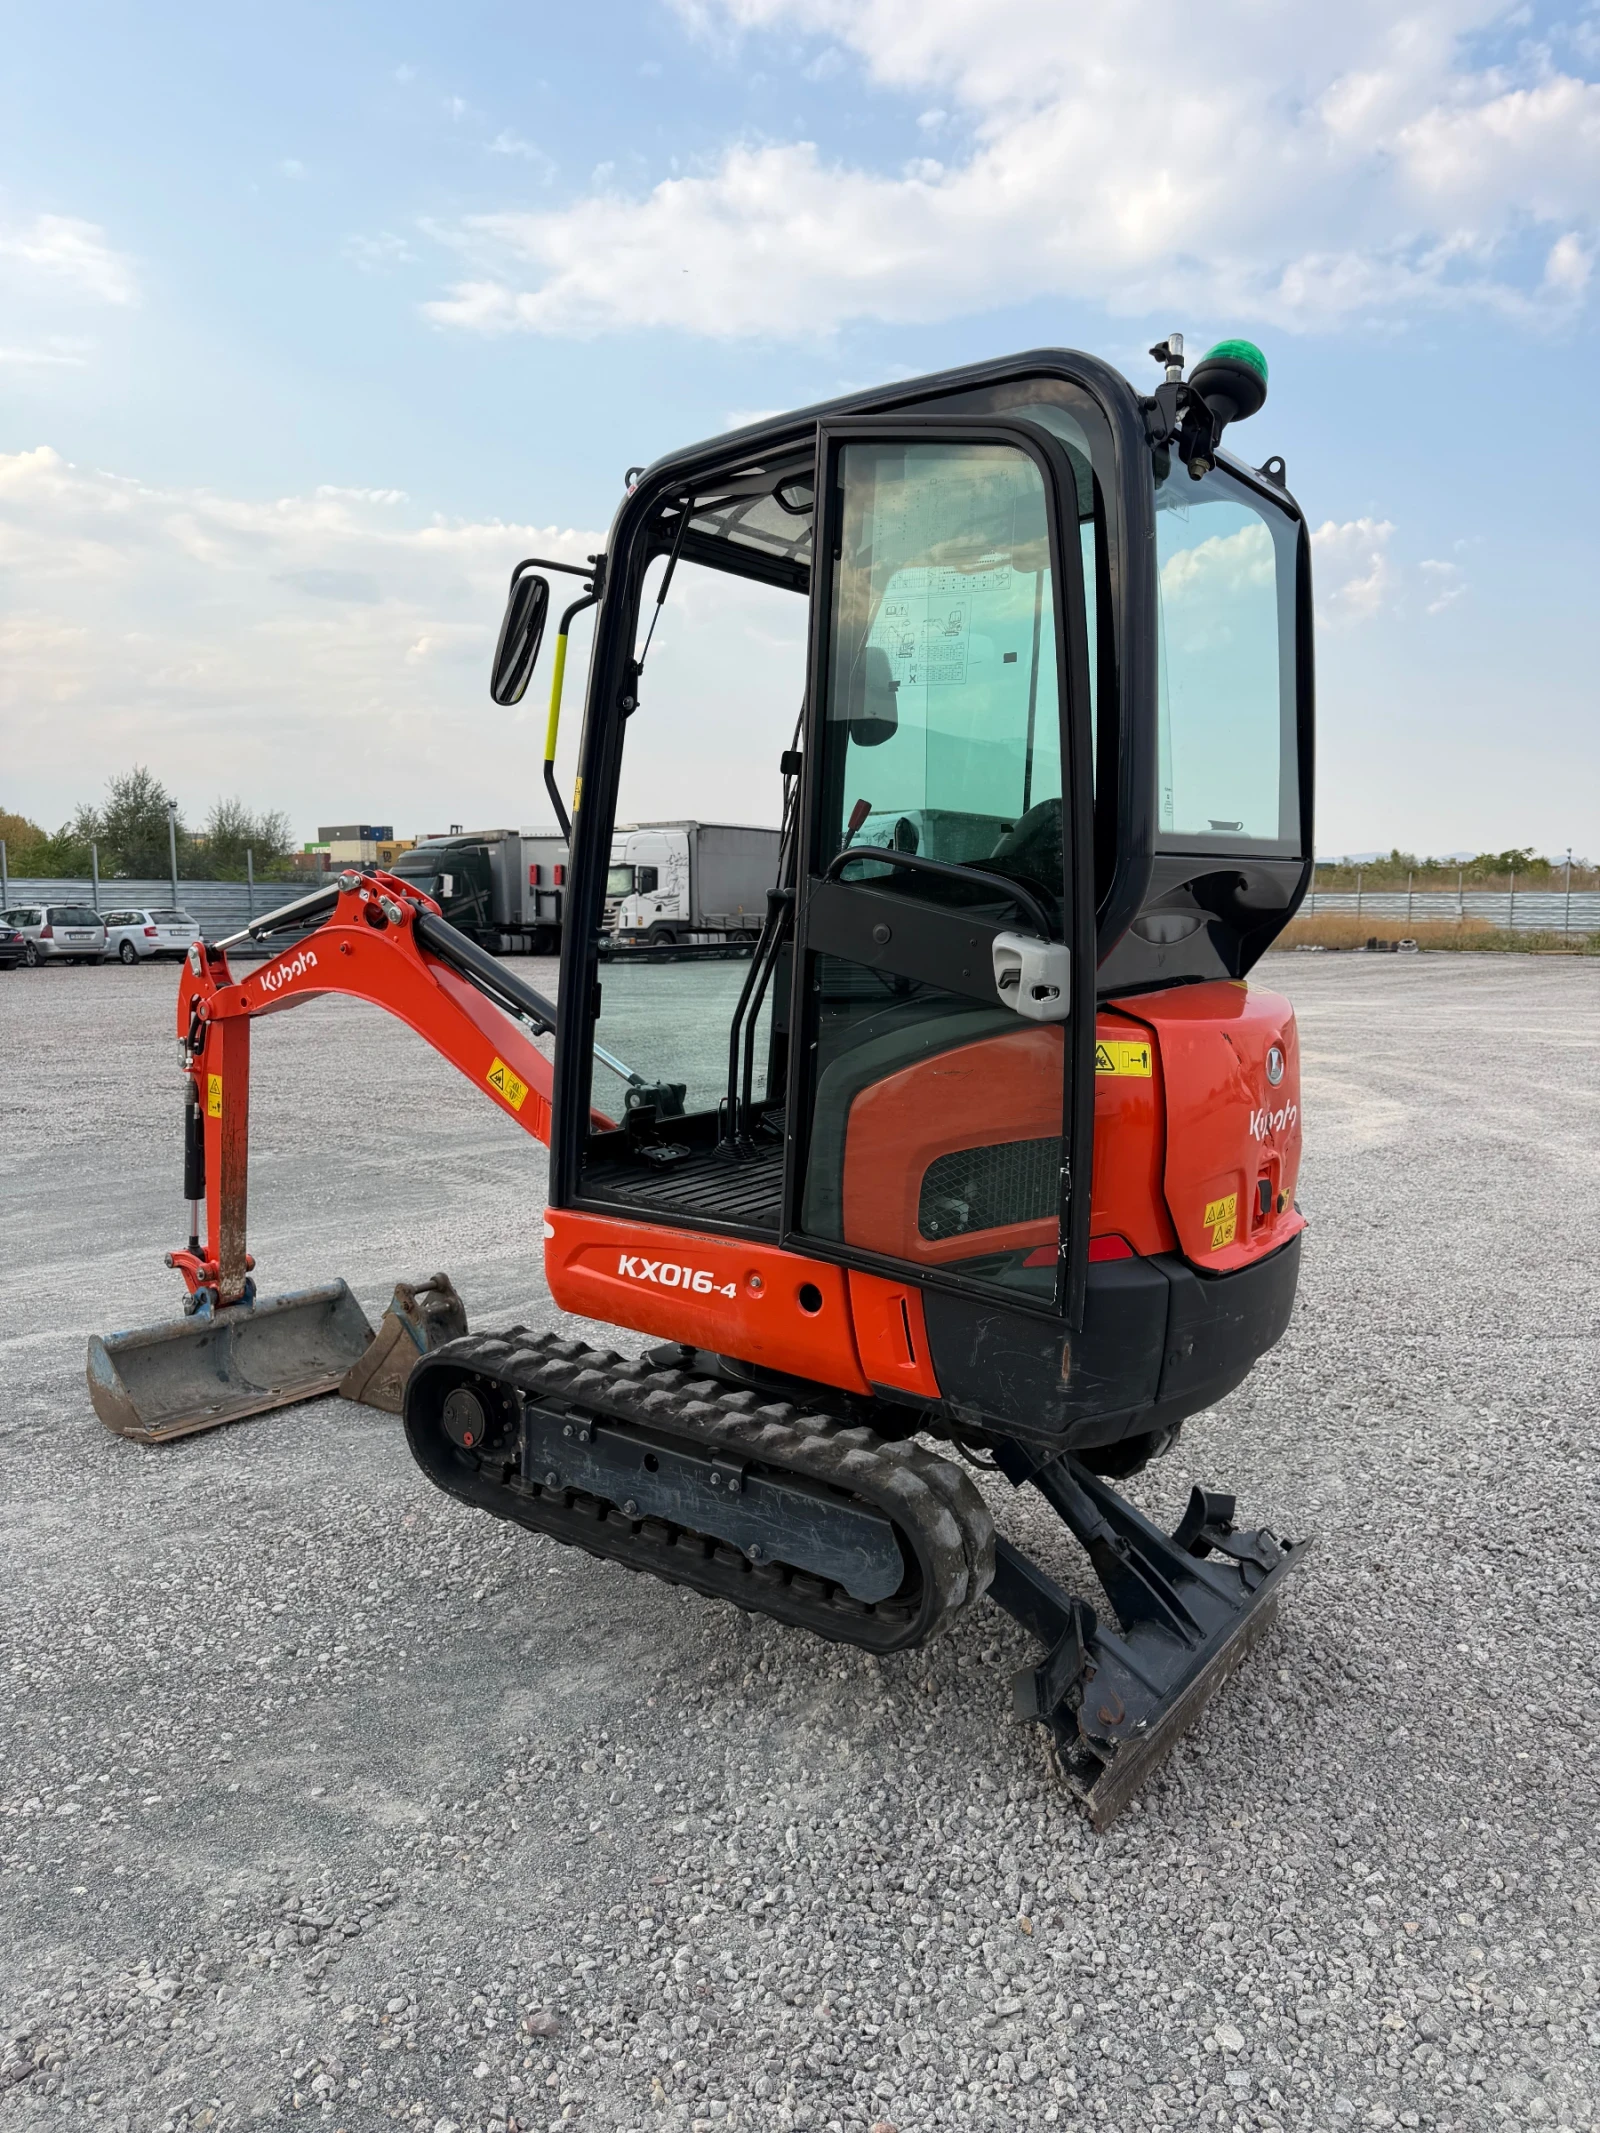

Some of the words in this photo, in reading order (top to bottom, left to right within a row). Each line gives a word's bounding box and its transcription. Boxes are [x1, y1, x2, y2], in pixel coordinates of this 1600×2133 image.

[260, 951, 318, 991] Kubota
[1249, 1099, 1297, 1141] Kubota
[618, 1254, 737, 1299] KX016-4
